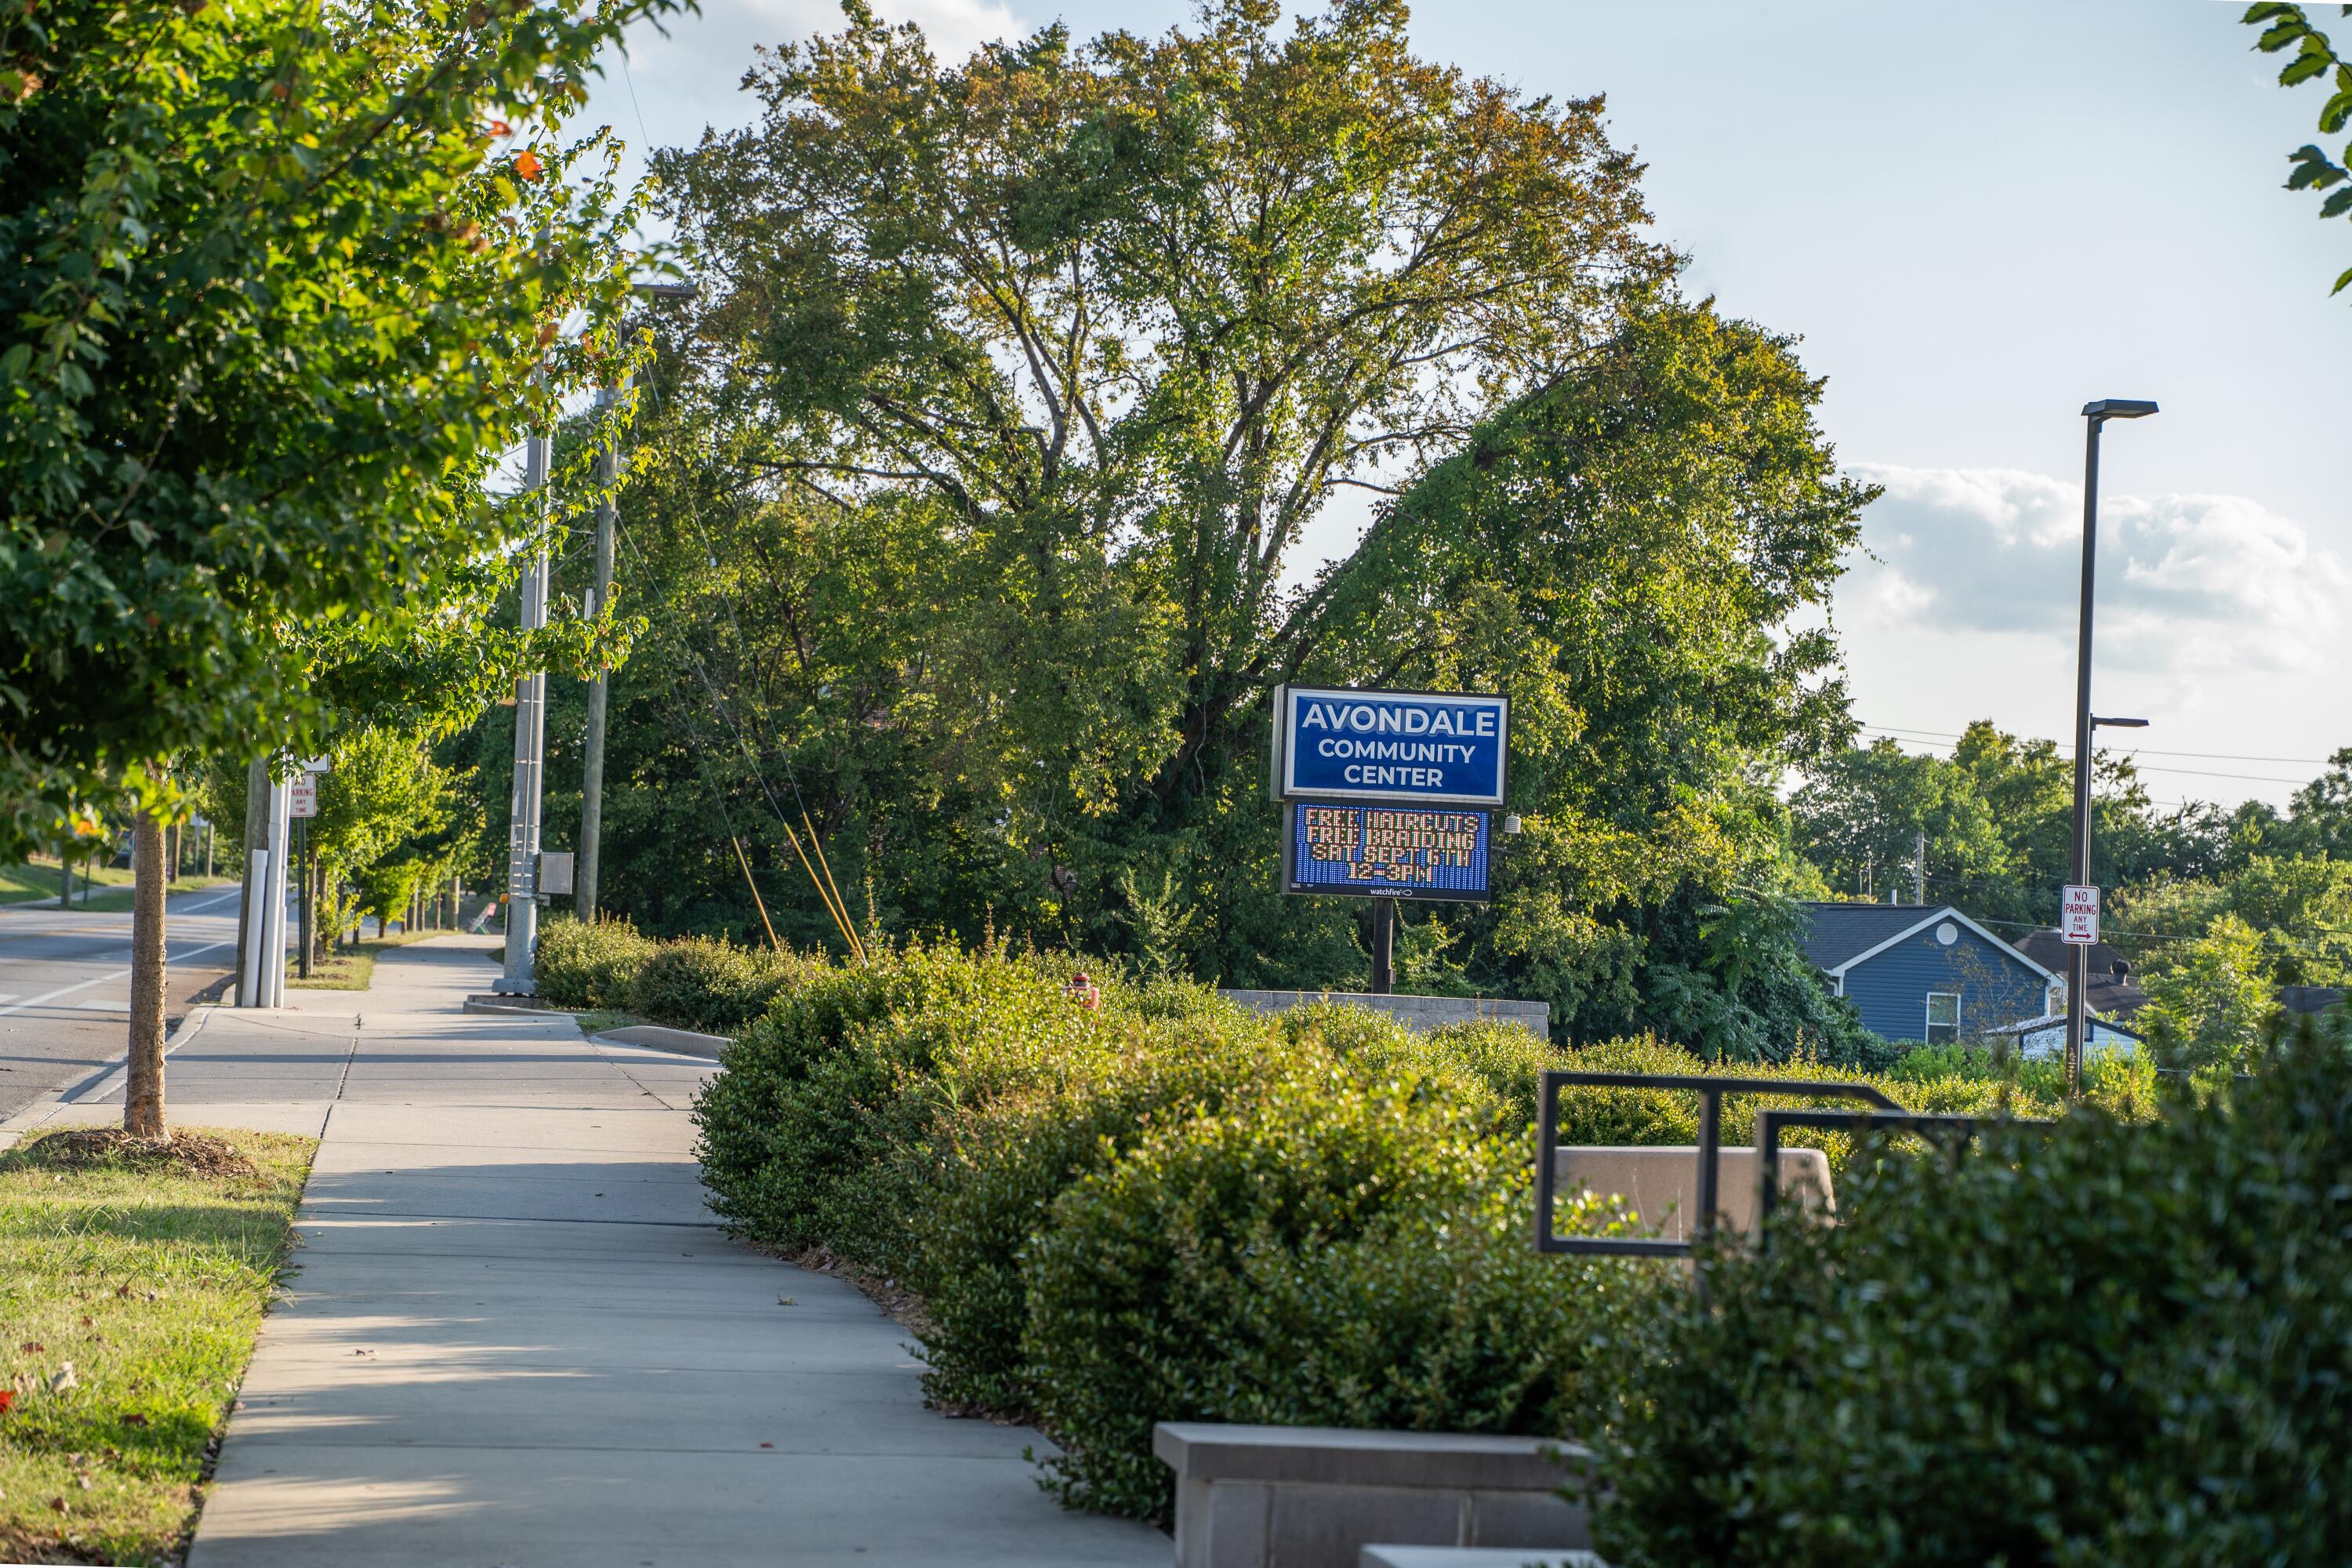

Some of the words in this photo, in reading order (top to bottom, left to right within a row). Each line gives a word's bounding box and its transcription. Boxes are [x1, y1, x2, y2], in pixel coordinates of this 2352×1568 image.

[1301, 704, 1495, 737] AVONDALE
[1318, 739, 1476, 764] COMMUNITY
[1344, 764, 1443, 787] CENTER
[1305, 808, 1359, 827] FREE
[1366, 811, 1479, 833] HAIRCUTS
[1307, 826, 1359, 844] FREE
[1367, 829, 1475, 850] BRAIDING
[1312, 844, 1357, 861] SAT
[1363, 846, 1421, 864] SEPT
[1427, 848, 1470, 867] 6TH
[1348, 862, 1432, 883] 12-3PM
[2074, 891, 2088, 902] NO
[2065, 903, 2096, 915] PARKING
